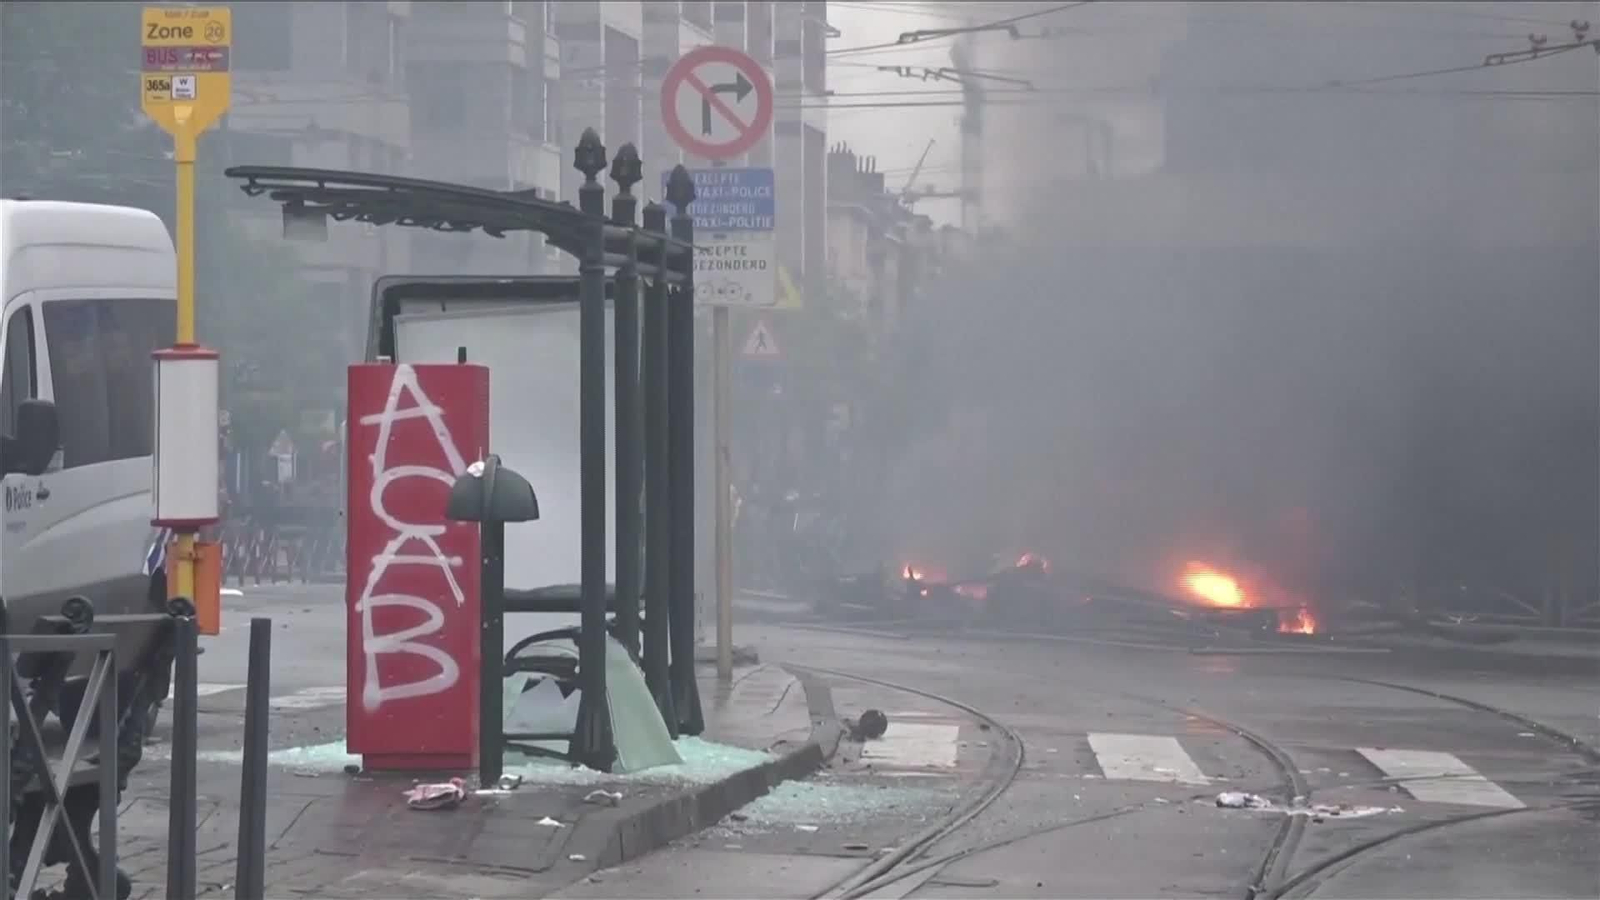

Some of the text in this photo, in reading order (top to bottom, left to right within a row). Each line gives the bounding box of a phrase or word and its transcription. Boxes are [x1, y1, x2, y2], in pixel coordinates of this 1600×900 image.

[147, 23, 194, 40] Zone
[147, 47, 179, 64] BUS
[146, 80, 170, 92] 365a
[13, 484, 32, 512] Police
[354, 362, 468, 711] ACAB
